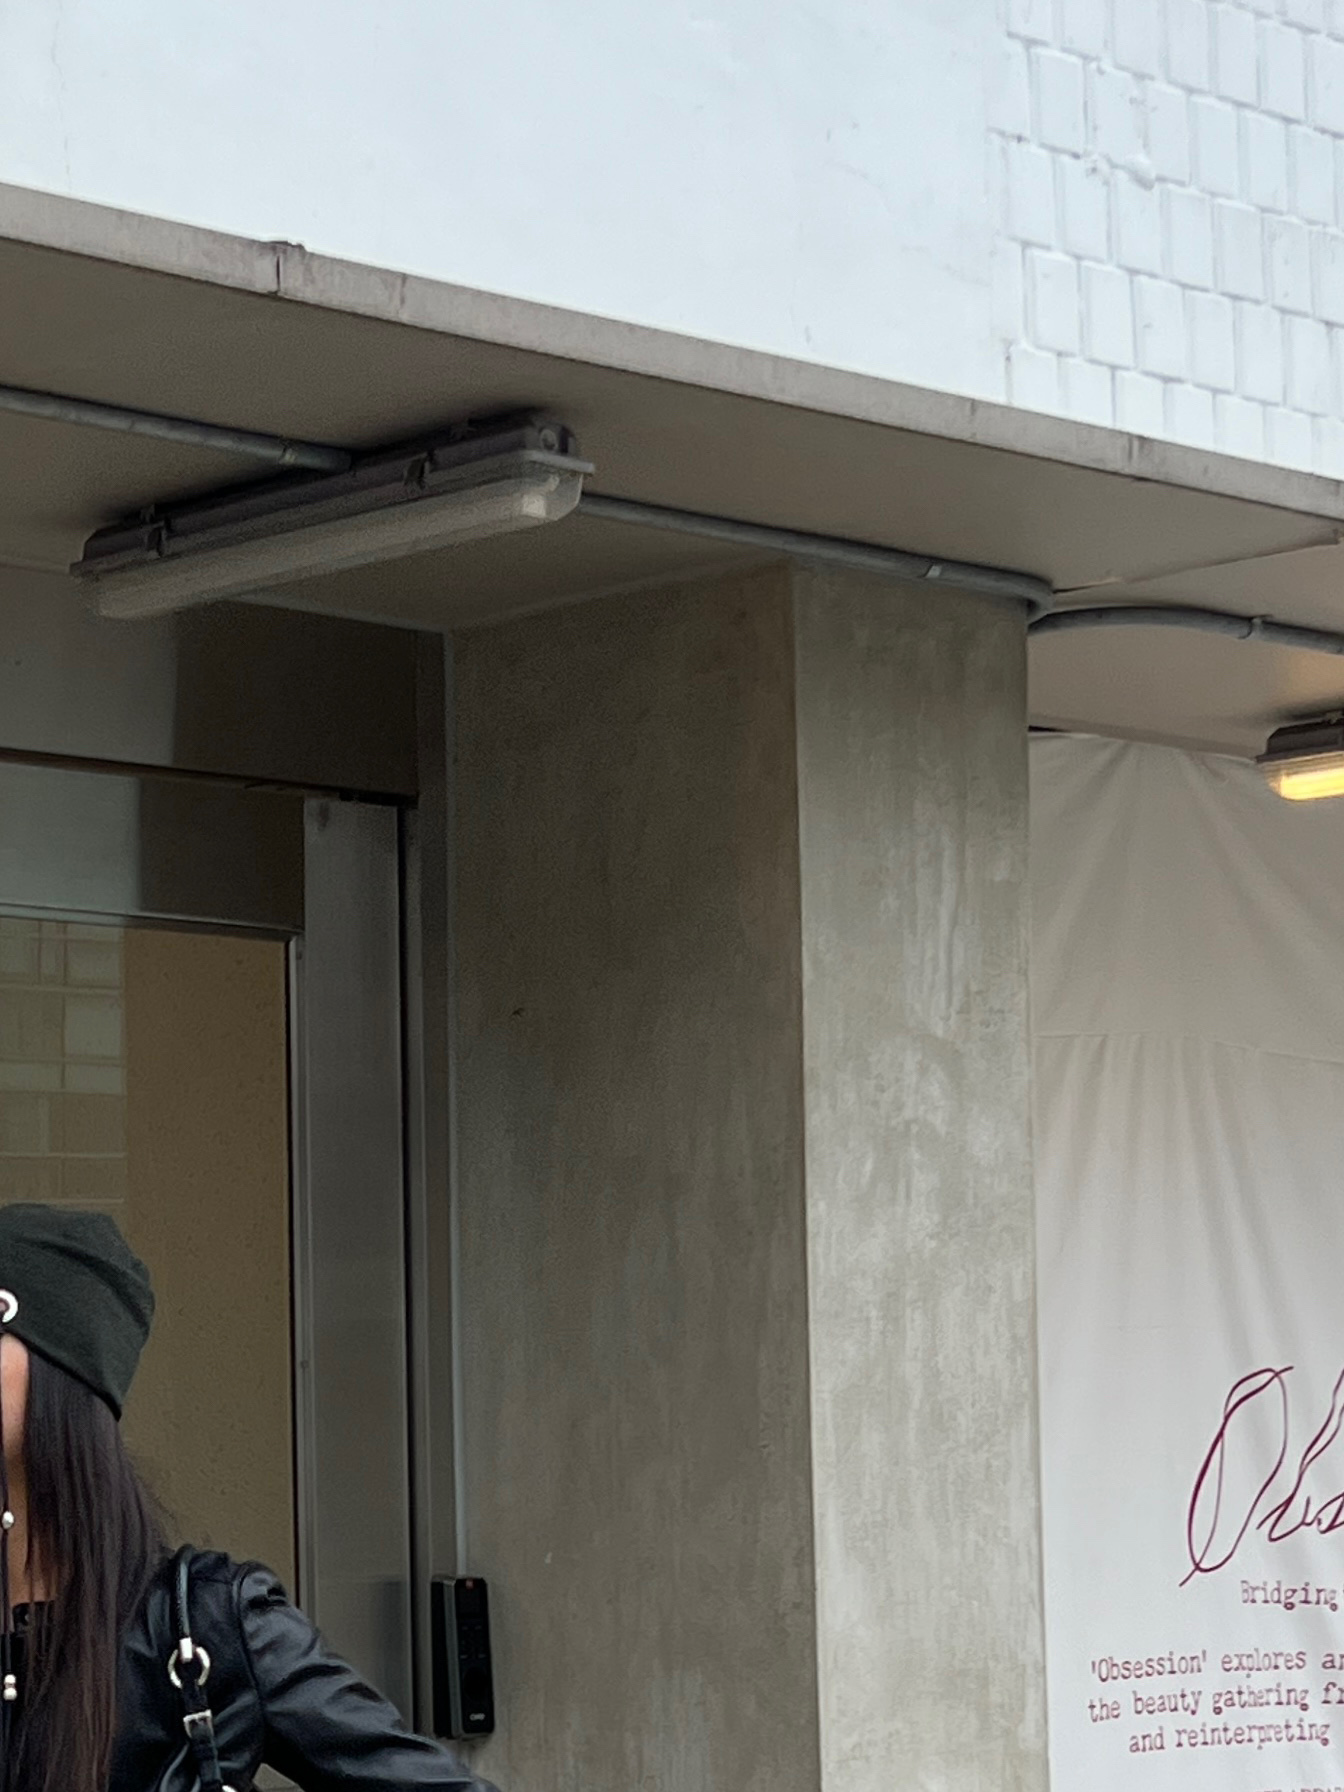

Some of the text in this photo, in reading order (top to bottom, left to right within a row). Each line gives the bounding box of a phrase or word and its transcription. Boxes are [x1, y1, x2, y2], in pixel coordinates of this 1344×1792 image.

[1240, 1580, 1338, 1612] Bridging
[1091, 1649, 1207, 1682] 'Obsession'
[1221, 1648, 1307, 1679] explores
[1088, 1698, 1121, 1723] the
[1131, 1688, 1203, 1715] beauty
[1212, 1682, 1309, 1715] gathering
[1129, 1717, 1331, 1753] and reinterpreting
